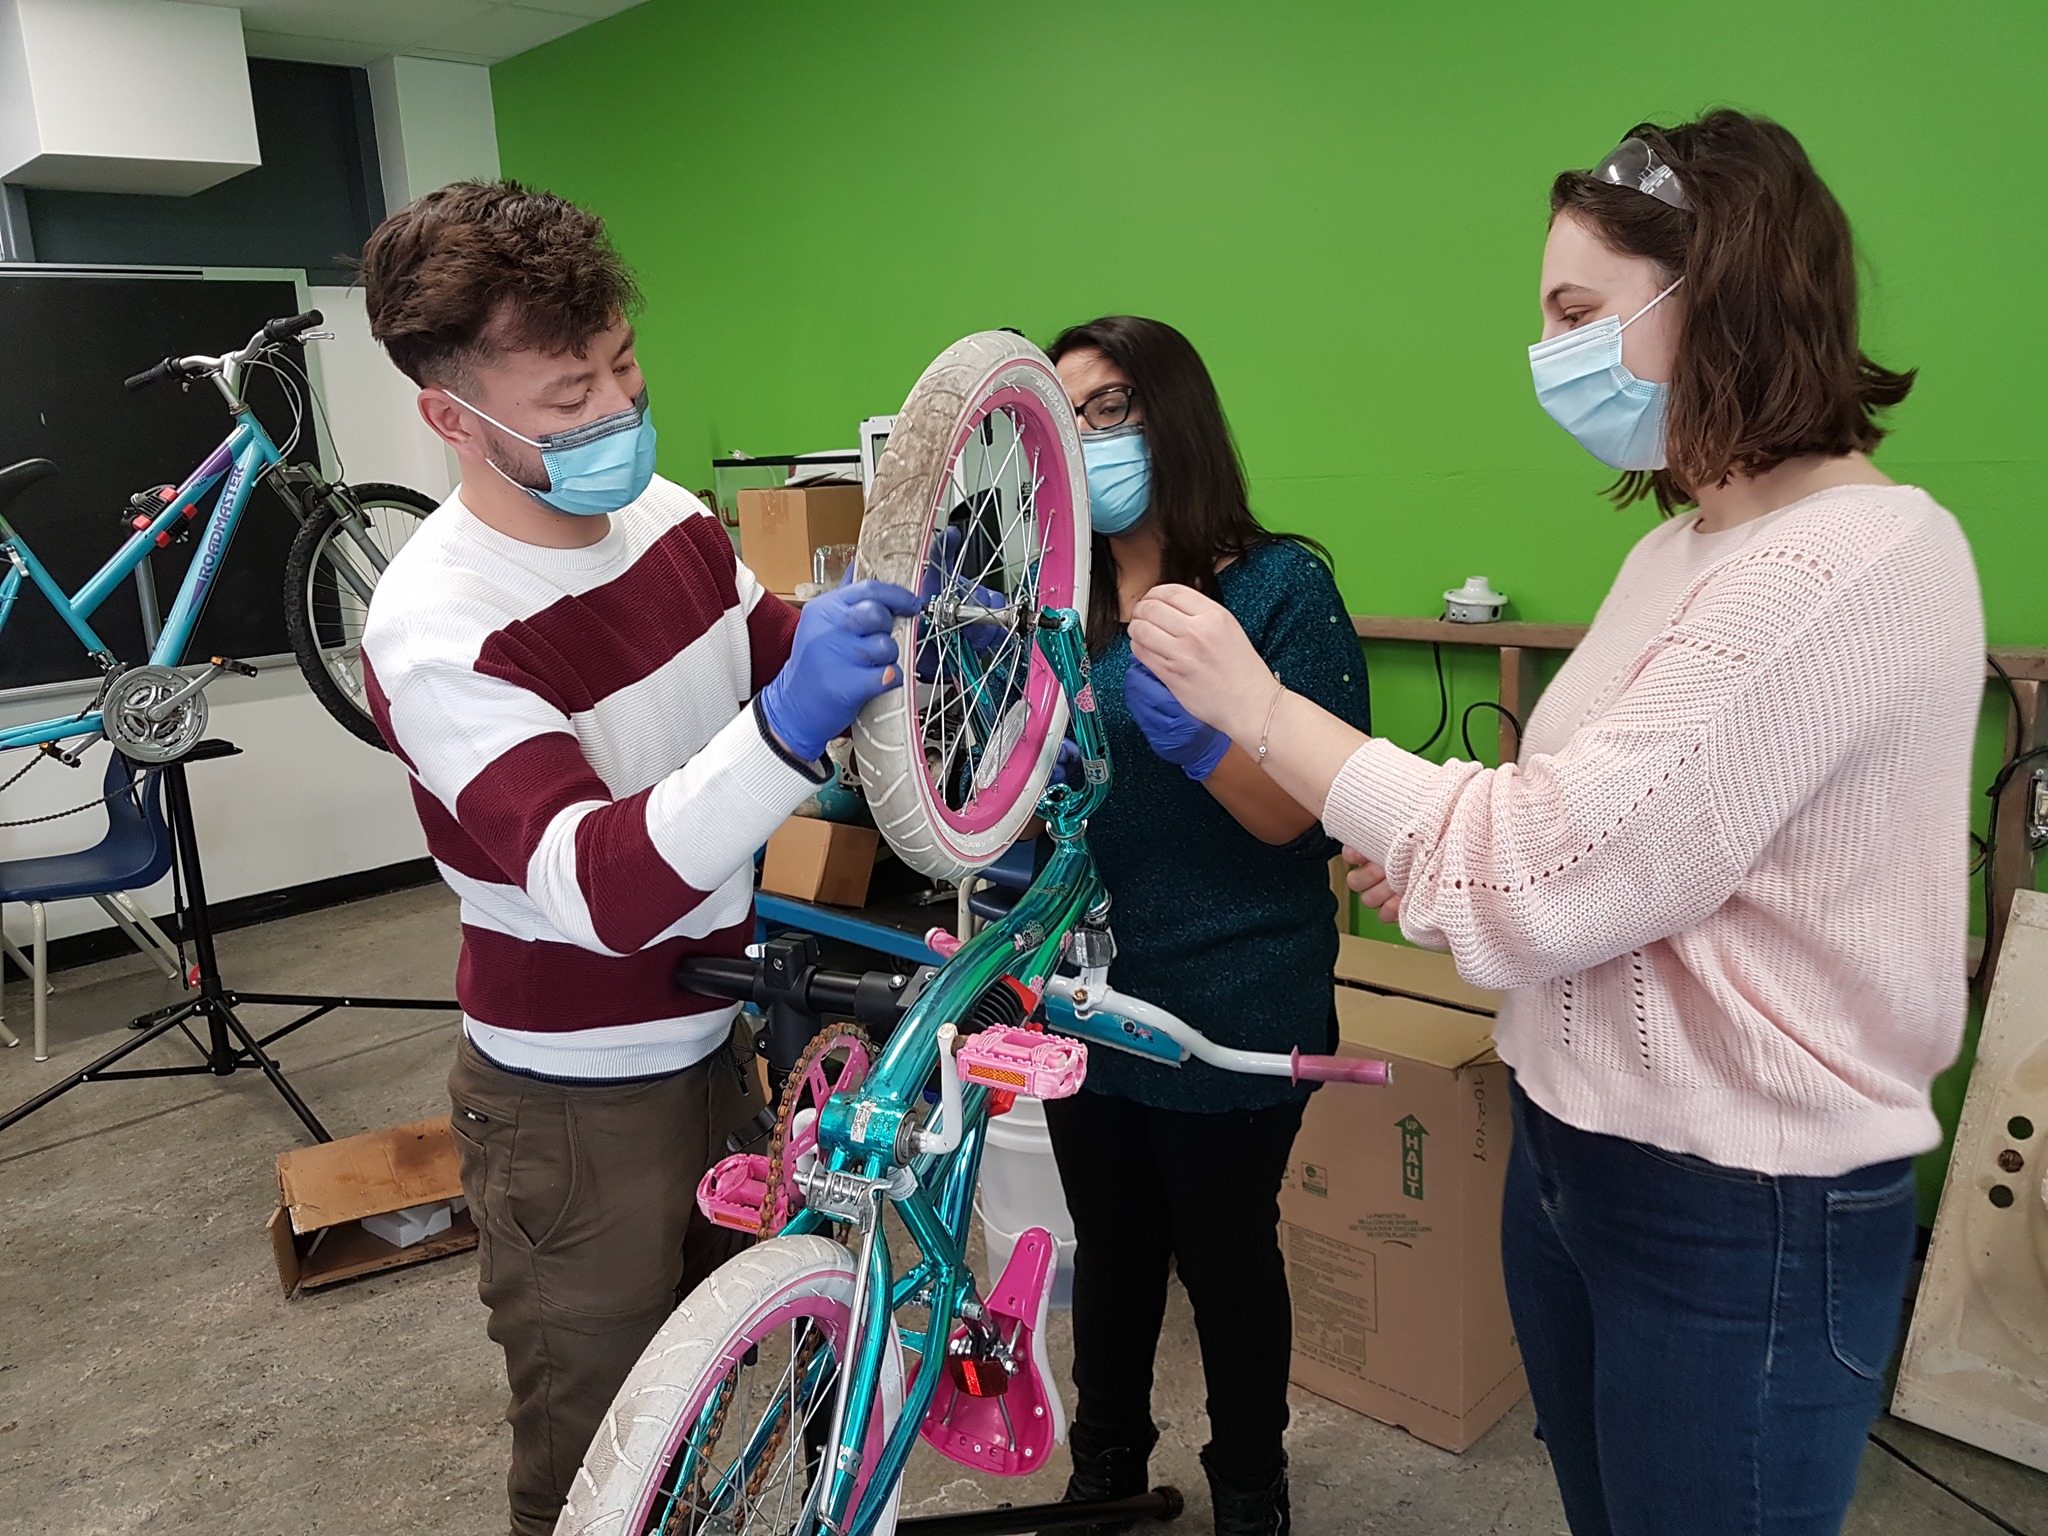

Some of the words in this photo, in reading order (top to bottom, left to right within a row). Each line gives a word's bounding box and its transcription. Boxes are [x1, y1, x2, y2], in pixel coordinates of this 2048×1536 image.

[199, 464, 244, 579] ROADMASTER
[1405, 1119, 1418, 1131] UP
[1405, 1134, 1420, 1196] HAUT
